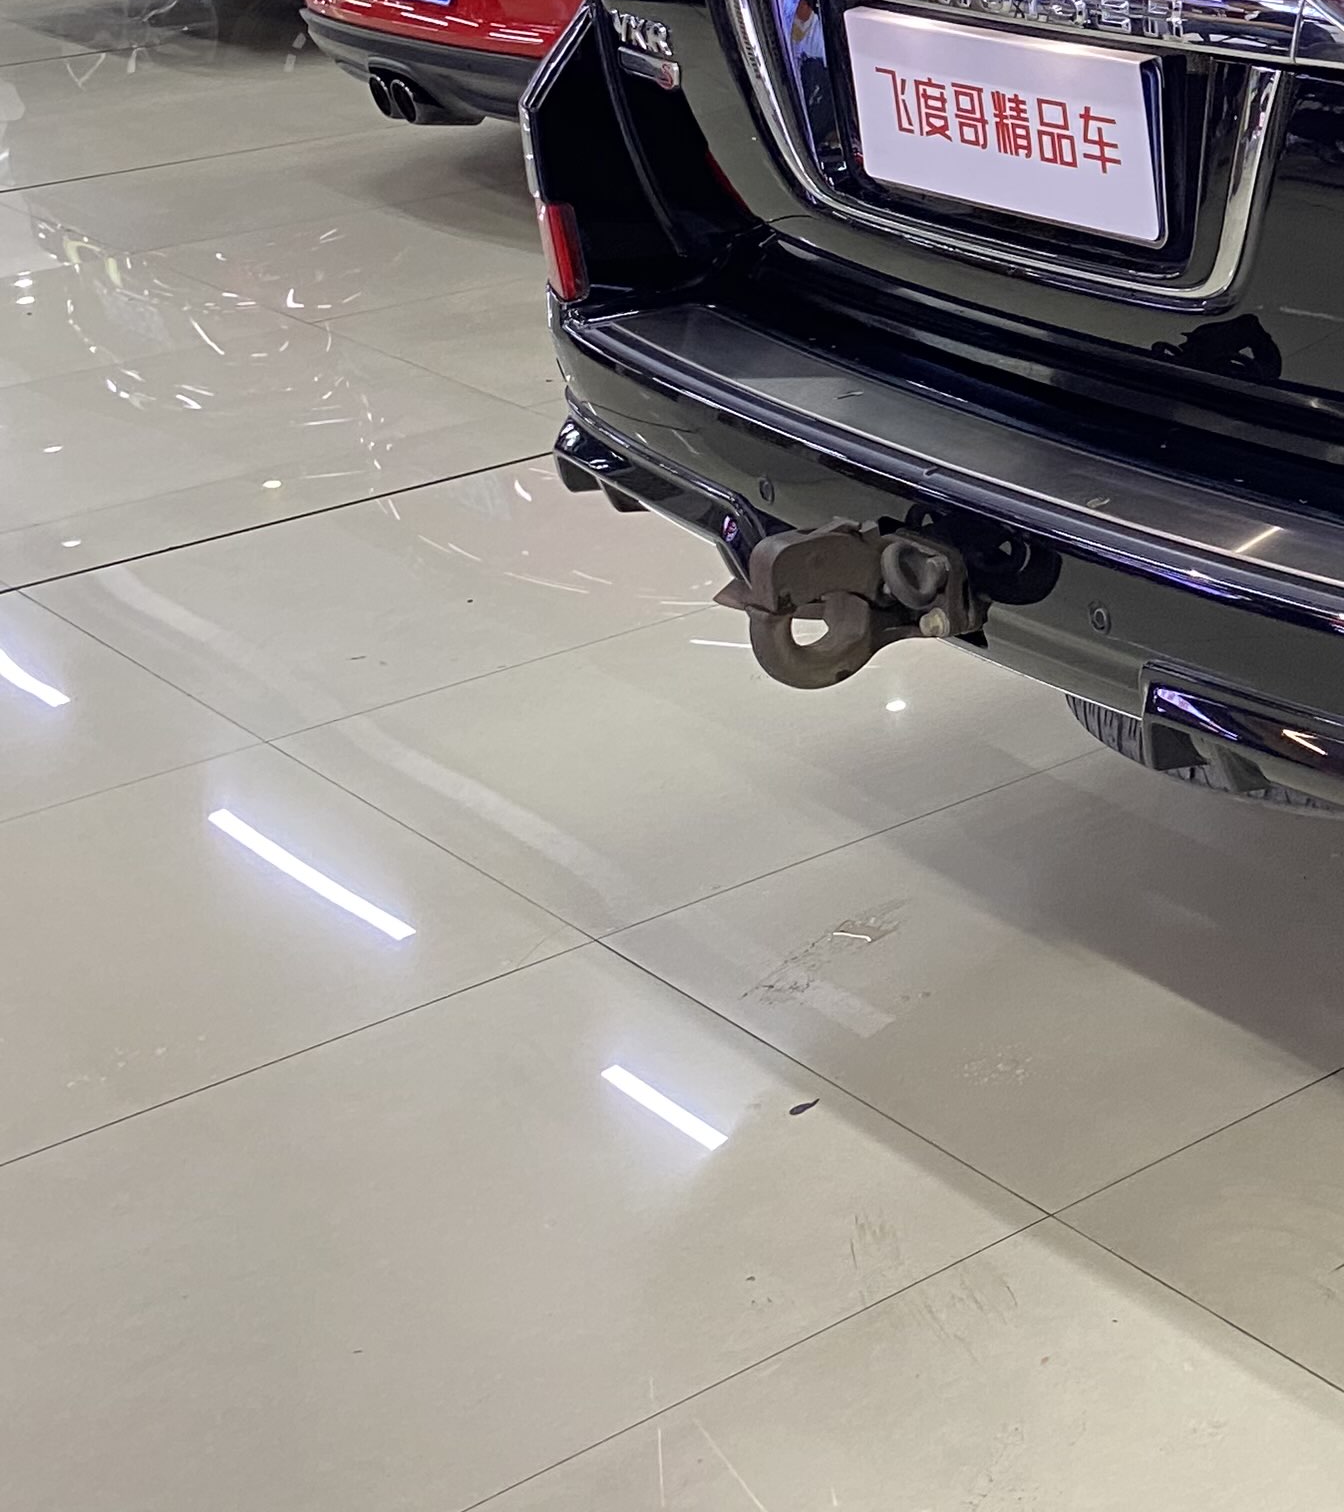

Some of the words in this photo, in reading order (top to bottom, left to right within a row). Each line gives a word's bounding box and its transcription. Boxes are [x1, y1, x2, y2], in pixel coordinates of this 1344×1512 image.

[875, 66, 1122, 174] 飞度哥精品车
